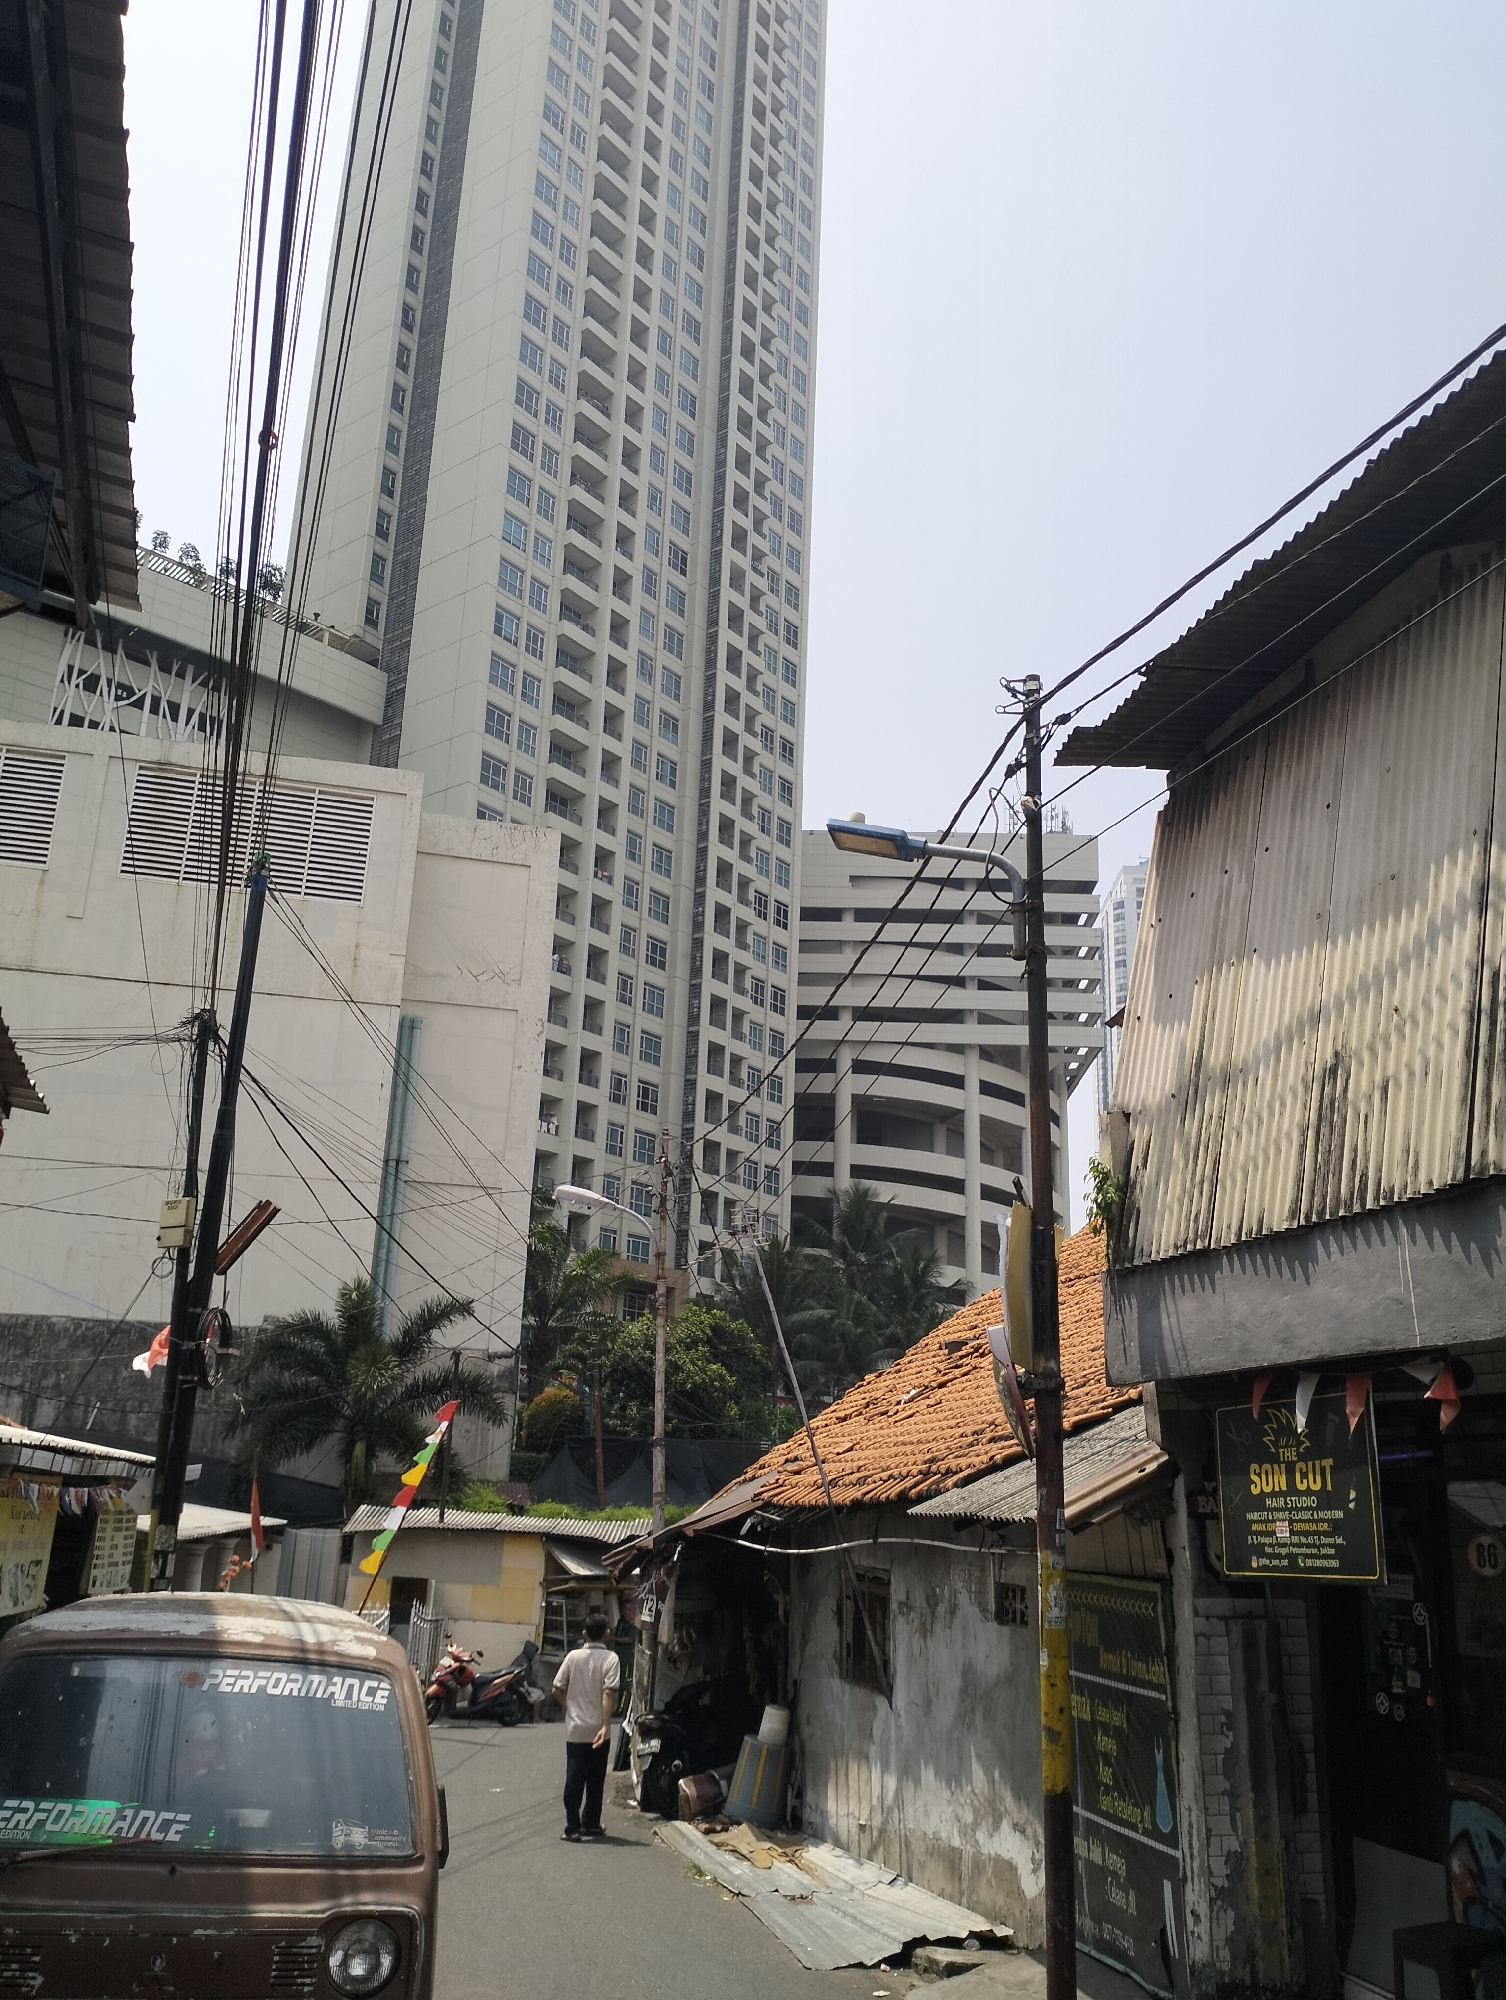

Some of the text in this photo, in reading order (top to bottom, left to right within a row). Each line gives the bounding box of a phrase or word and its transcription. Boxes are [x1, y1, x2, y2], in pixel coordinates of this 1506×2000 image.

[1279, 1447, 1297, 1461] THE
[1250, 1458, 1333, 1494] SON CUT
[1197, 1496, 1219, 1513] BA
[1266, 1496, 1317, 1508] HAIR STUDIO
[1246, 1512, 1268, 1520] HAIRCUT
[1318, 1510, 1344, 1519] MODERN
[1251, 1523, 1267, 1531] ANAK
[1293, 1523, 1317, 1531] DEWASA
[1258, 1536, 1272, 1545] Palapa
[1274, 1546, 1289, 1555] Grogol
[1320, 1546, 1336, 1555] Jakbar
[1476, 1542, 1498, 1569] 86
[1258, 1556, 1288, 1566] @the_son_cut
[201, 1669, 392, 1704] PERFORMANCE
[331, 1699, 385, 1712] LIMITED EDITION
[0, 1800, 192, 1842] ERFORMANCE
[0, 1829, 31, 1840] EDITION
